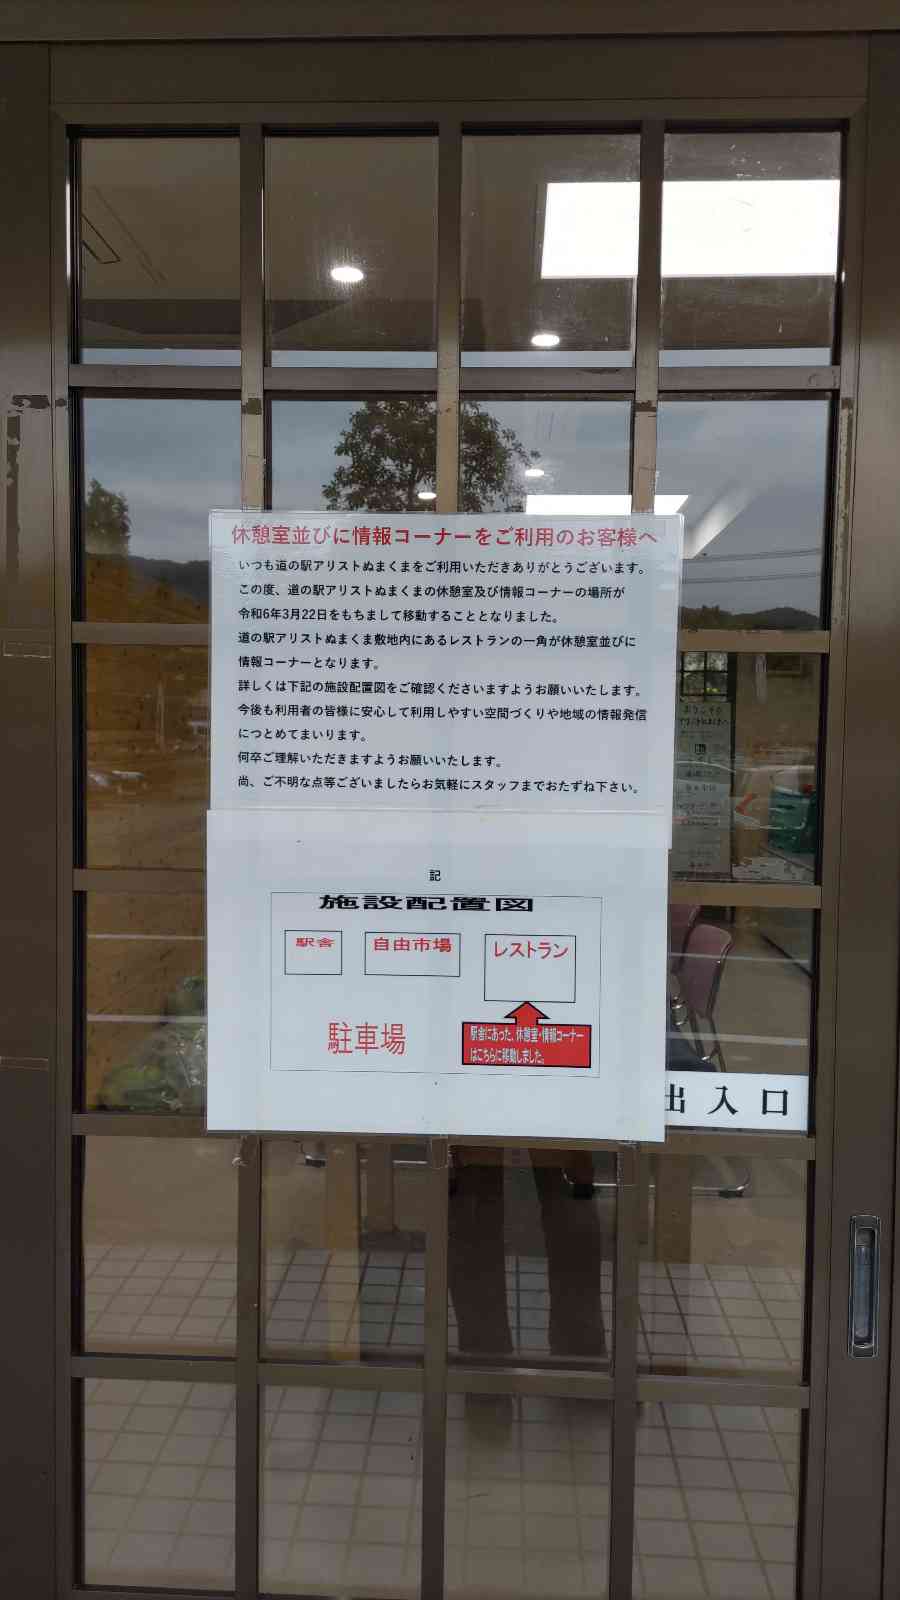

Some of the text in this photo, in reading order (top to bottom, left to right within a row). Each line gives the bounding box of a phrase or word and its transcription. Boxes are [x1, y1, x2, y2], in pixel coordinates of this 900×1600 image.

[231, 524, 657, 547] 休憩室並びに情報コーナーをご利用のお客様へ
[239, 559, 646, 575] いつも道の駅アリストぬまくまをご利用いただきありがとうございます。
[239, 583, 625, 599] この度、道の駅アリストぬまくまの休憩室及び情報コーナーの場所が
[238, 608, 559, 623] 令和6年3月22日をもちまして移動することとなりました。
[238, 632, 636, 648] 道の駅アリストぬまくま敷地内にあるレストランの一角が休憩室並びに
[238, 656, 380, 670] 情報コーナーとなります。
[238, 679, 641, 697] 詳しくは下記の施設配置図をご確認くださいますようお願いいたします。
[238, 703, 647, 721] 今後も利用者の皆様に安心して利用しやすい空間づくりや地域の情報発信
[238, 728, 368, 742] につとめてまいります。
[238, 752, 502, 768] 何卒ご理解いただきますようお願いいたします。
[238, 775, 639, 794] 尚、ご不明な点等ございましたらお気軽にスタッフまでおたずね下さい。
[429, 869, 441, 882] 記
[319, 894, 534, 913] 施設配置図
[295, 936, 335, 948] 駅舎
[373, 936, 453, 954] 自由市場
[494, 940, 569, 960] レストラン
[327, 1021, 407, 1057] 駐車場
[664, 1083, 788, 1116] 出入口
